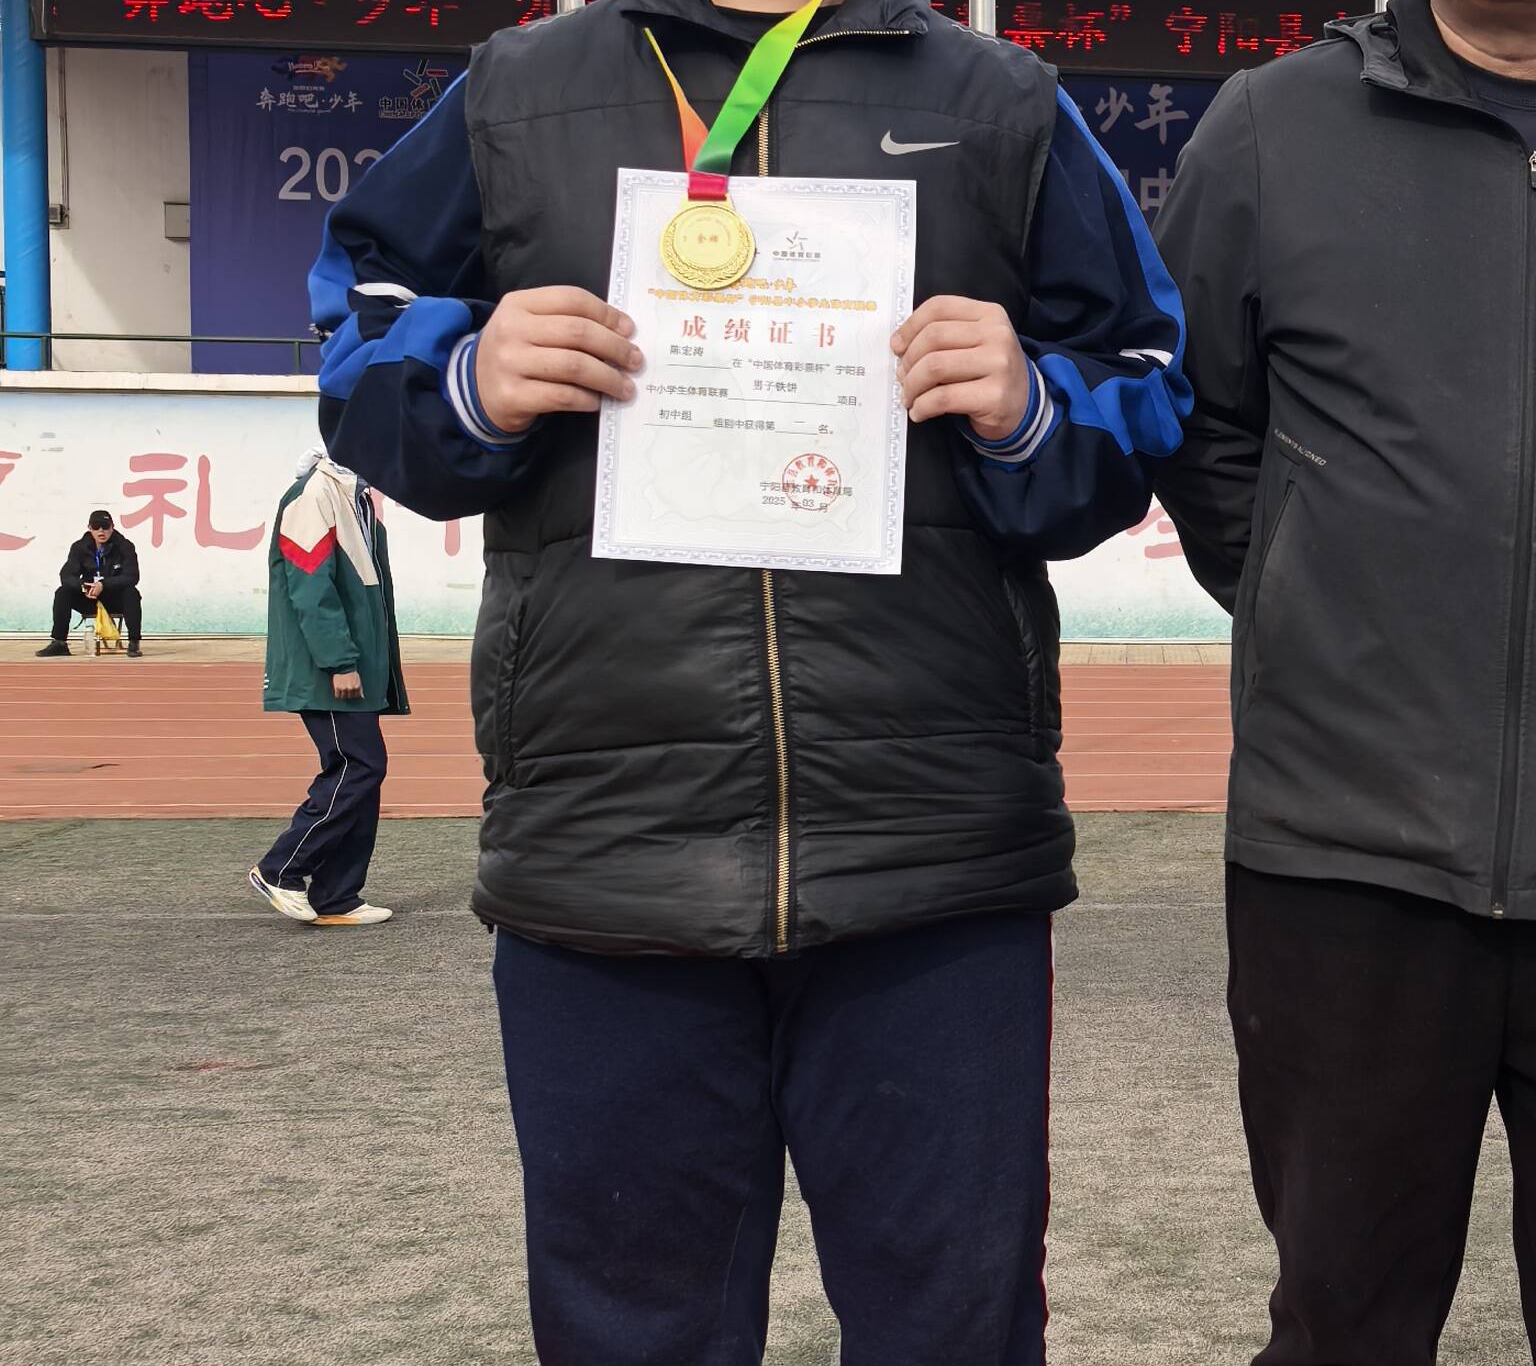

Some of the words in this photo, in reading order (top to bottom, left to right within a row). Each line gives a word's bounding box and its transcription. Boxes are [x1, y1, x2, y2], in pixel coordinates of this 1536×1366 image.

[681, 314, 837, 347] 成绩证书
[120, 452, 266, 551] 礼
